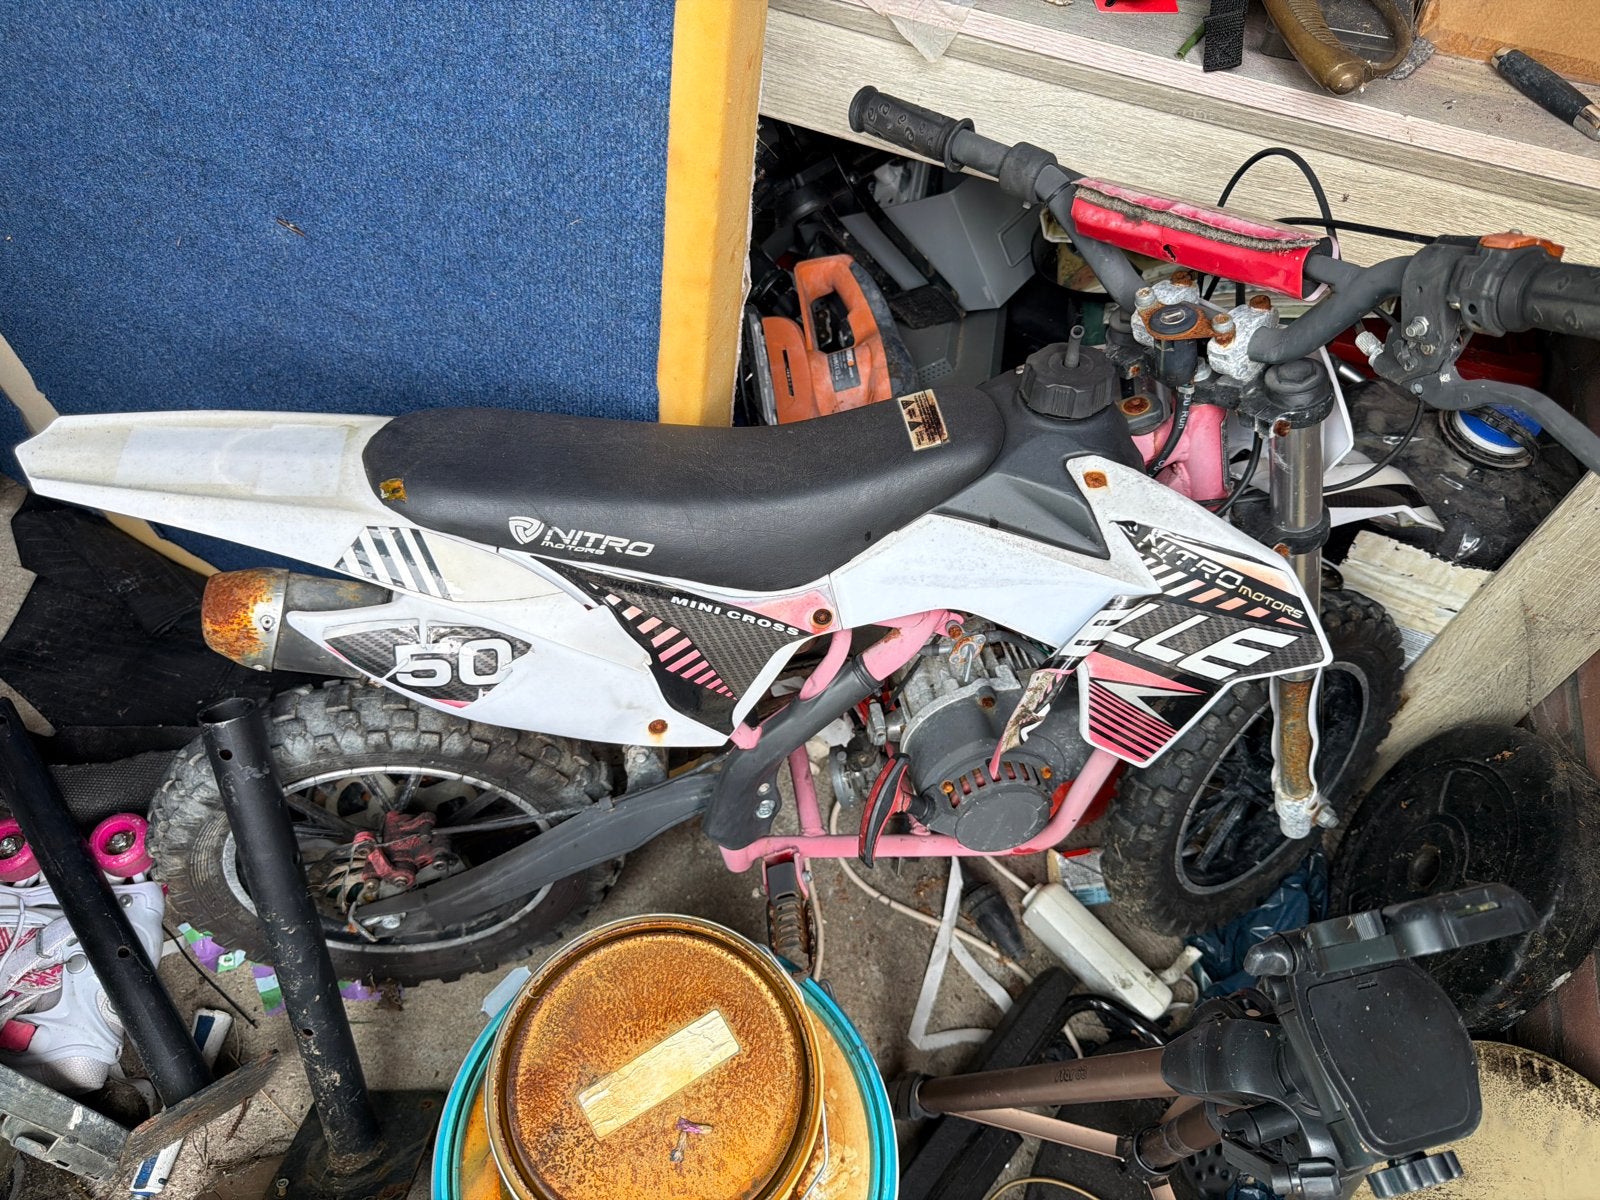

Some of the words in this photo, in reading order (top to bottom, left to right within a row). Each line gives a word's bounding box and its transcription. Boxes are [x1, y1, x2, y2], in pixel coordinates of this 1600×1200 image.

[540, 540, 606, 556] MOTORS
[544, 526, 656, 557] NITRO
[1137, 533, 1244, 589] NITRO
[1238, 585, 1305, 620] MOTORS
[670, 596, 722, 615] MINI
[726, 610, 800, 636] CROSS
[395, 637, 513, 688] 50
